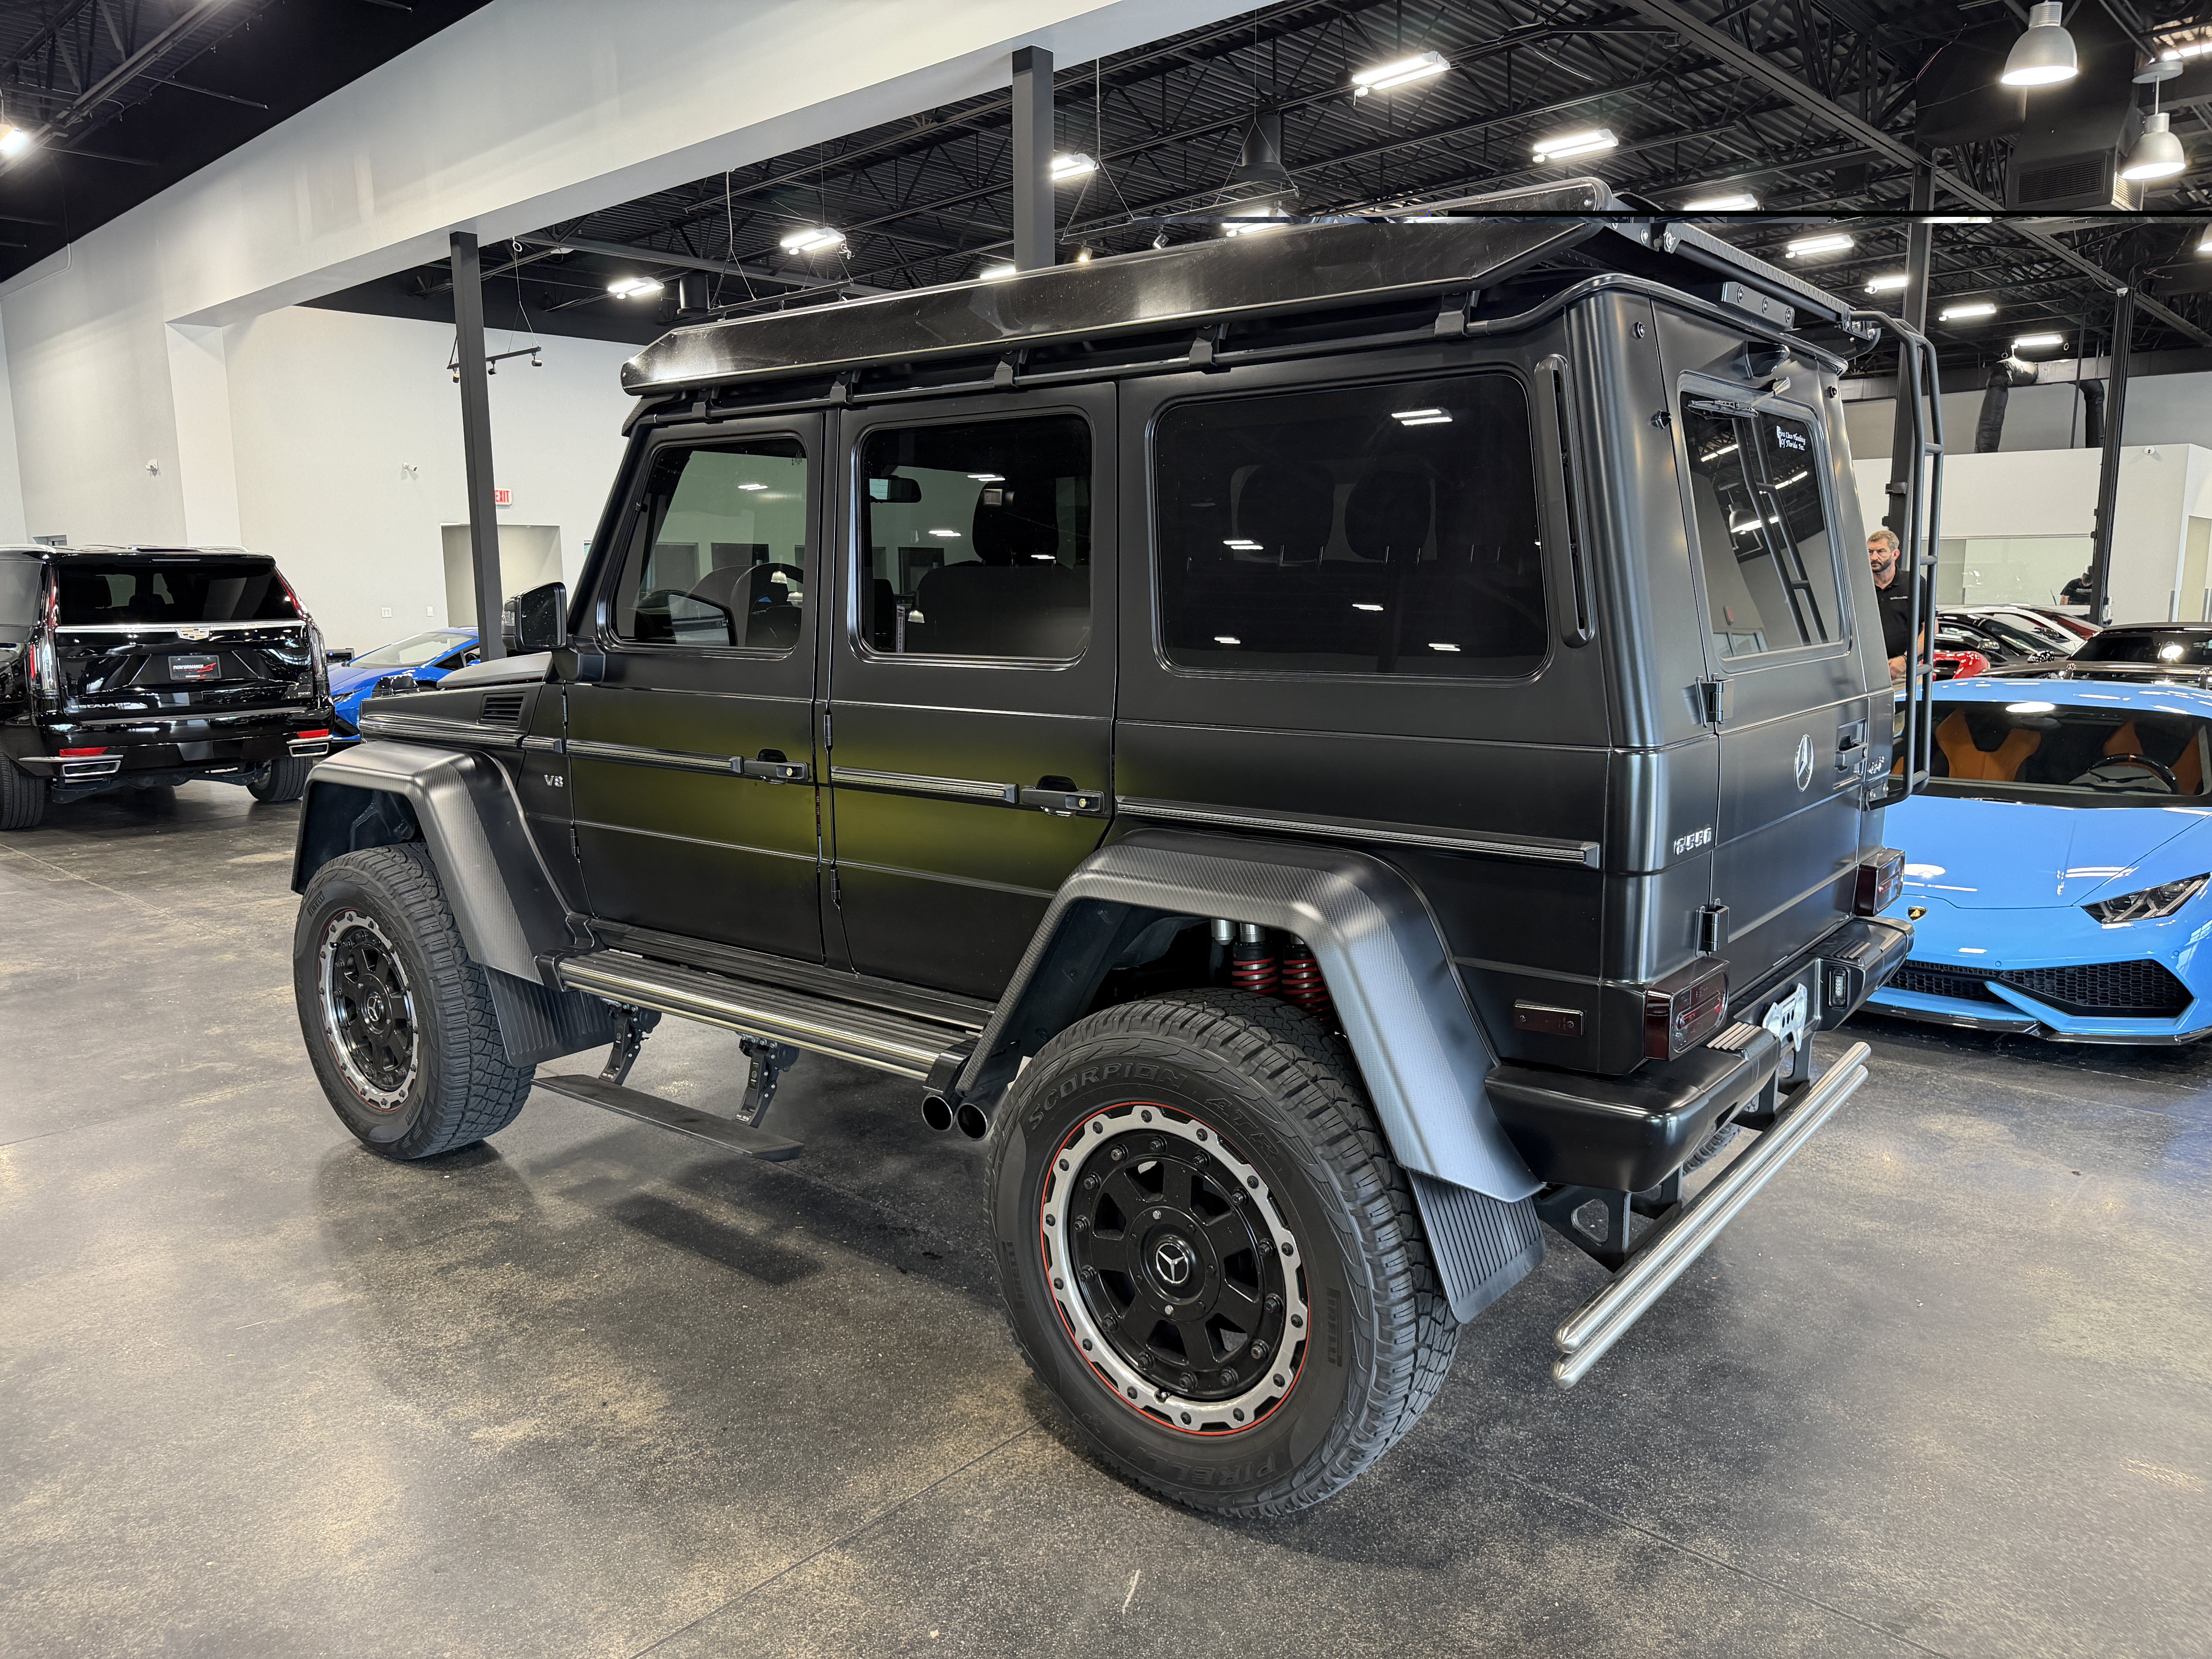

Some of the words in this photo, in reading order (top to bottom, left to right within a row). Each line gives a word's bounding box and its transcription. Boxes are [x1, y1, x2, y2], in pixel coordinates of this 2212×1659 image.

[495, 490, 510, 503] EXIT
[544, 775, 563, 787] V8
[1674, 828, 1712, 855] G550
[307, 890, 325, 917] PIRELLI
[1029, 1063, 1187, 1130] SCORPION
[1204, 1098, 1279, 1159] ATR
[1126, 1446, 1275, 1486] PIRELLI
